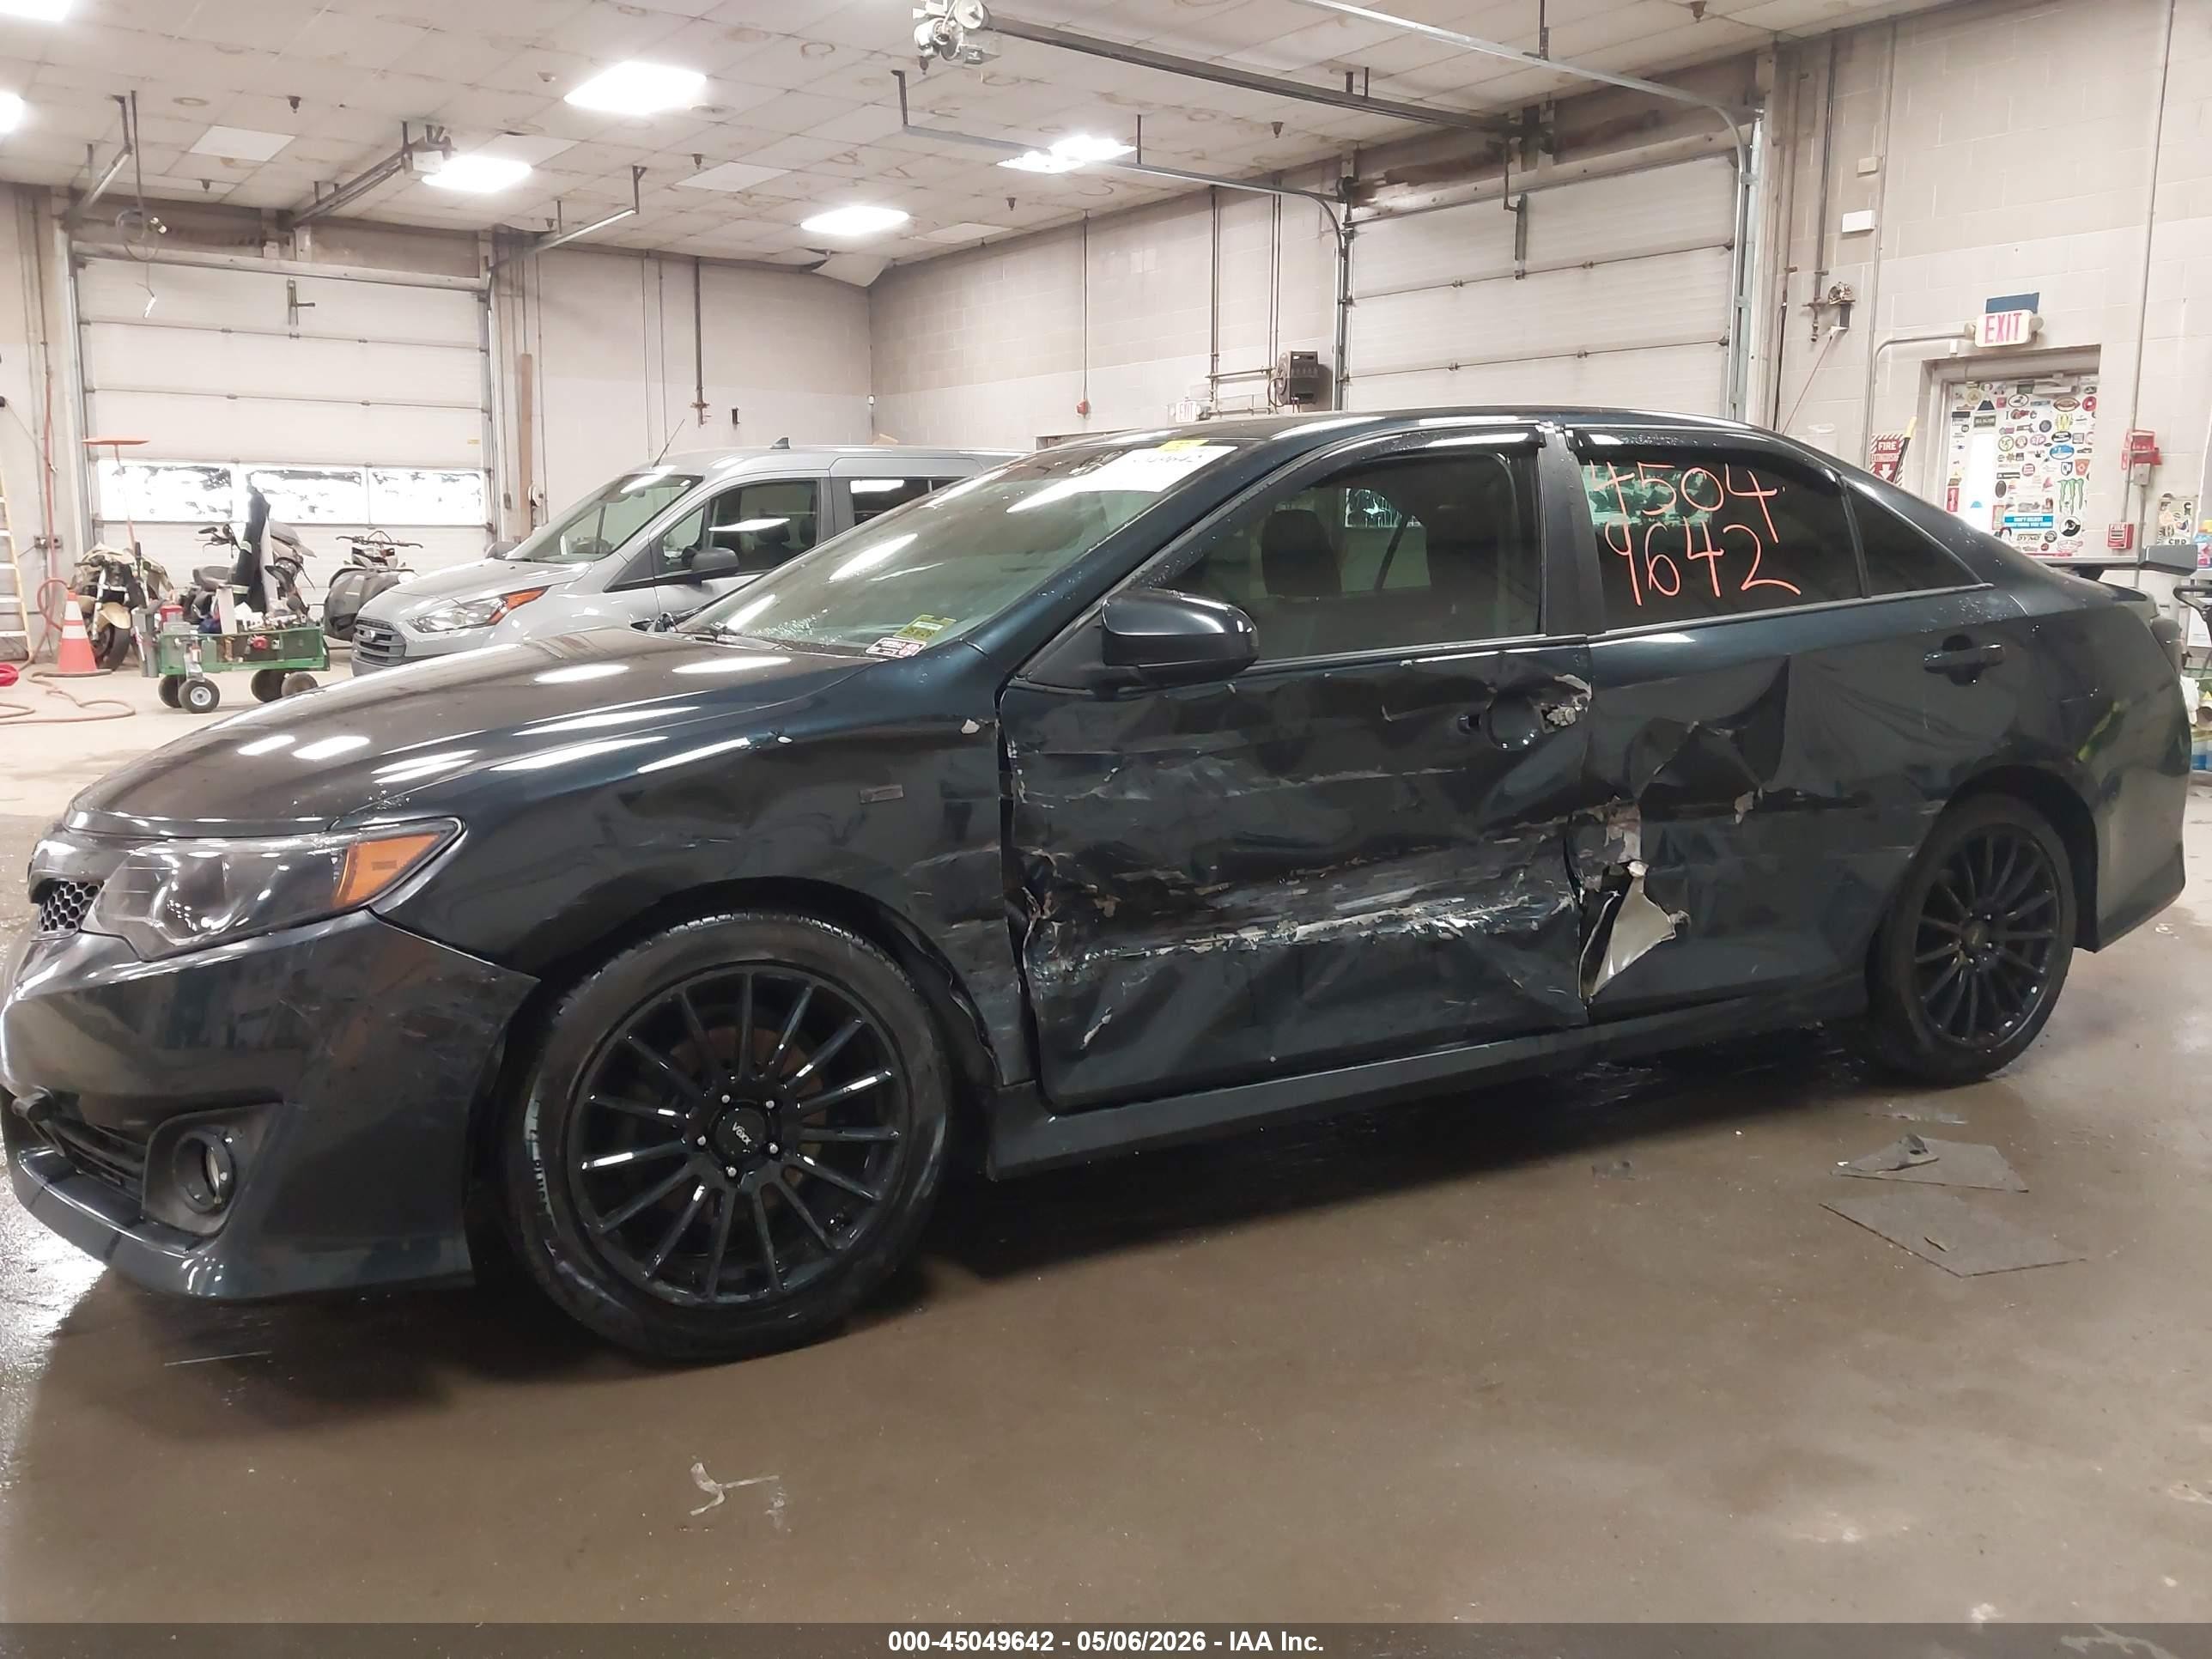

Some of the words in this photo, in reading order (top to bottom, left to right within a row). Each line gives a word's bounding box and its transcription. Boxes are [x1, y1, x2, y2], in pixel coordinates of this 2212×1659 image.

[1984, 313, 2022, 344] EXIT
[1878, 441, 1897, 451] FIRE
[1590, 459, 1779, 544] 4504
[1604, 516, 1802, 606] 9642
